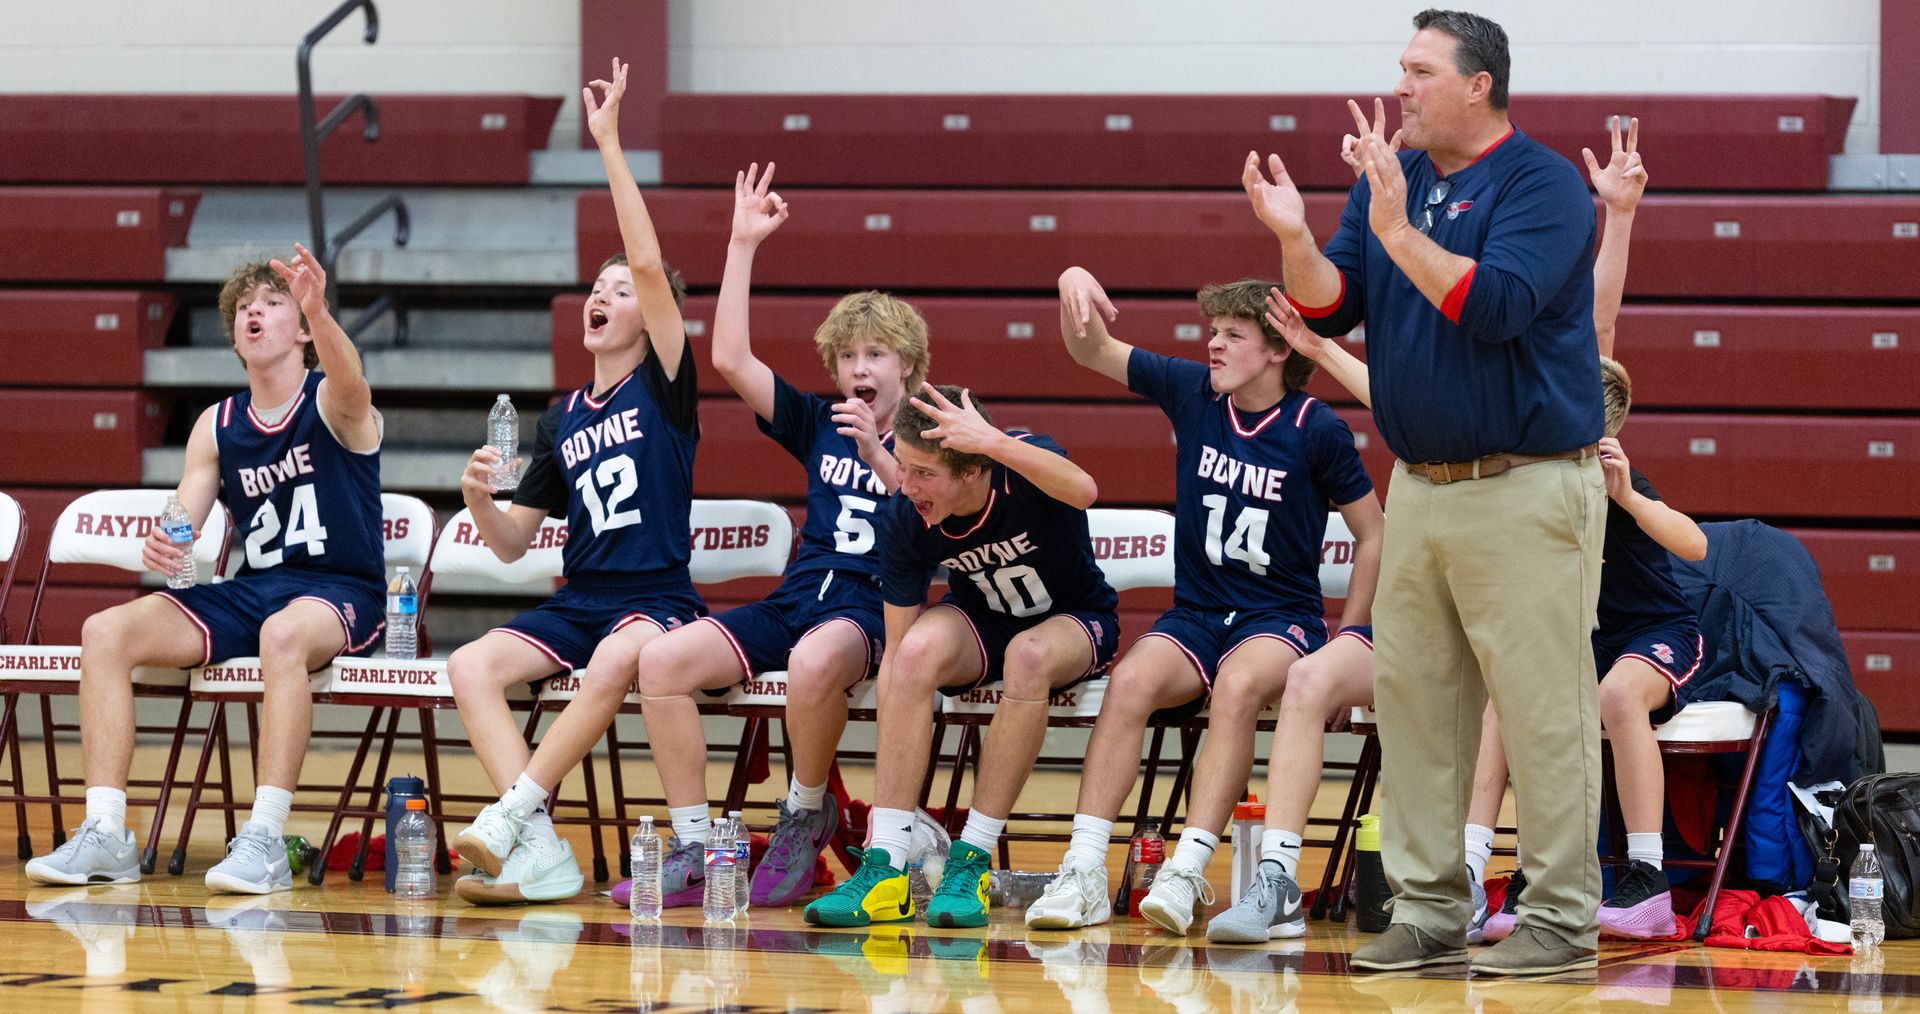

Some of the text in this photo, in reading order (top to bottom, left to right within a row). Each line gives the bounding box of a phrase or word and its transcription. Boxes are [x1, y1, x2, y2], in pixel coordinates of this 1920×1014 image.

[560, 407, 644, 470] BOYNE
[575, 453, 642, 538] 12
[819, 454, 892, 496] BOYN
[1197, 444, 1288, 502] BOYNE
[75, 513, 161, 538] RAYD
[245, 483, 328, 570] 24
[689, 524, 770, 551] YDERS
[833, 494, 878, 555] 5
[1089, 534, 1167, 560] DERS
[1202, 494, 1271, 576] 14
[968, 564, 1053, 618] 10
[0, 655, 82, 670] CHARLEVO
[203, 667, 265, 683] CHARLE
[340, 667, 438, 685] CHARLEVOIX
